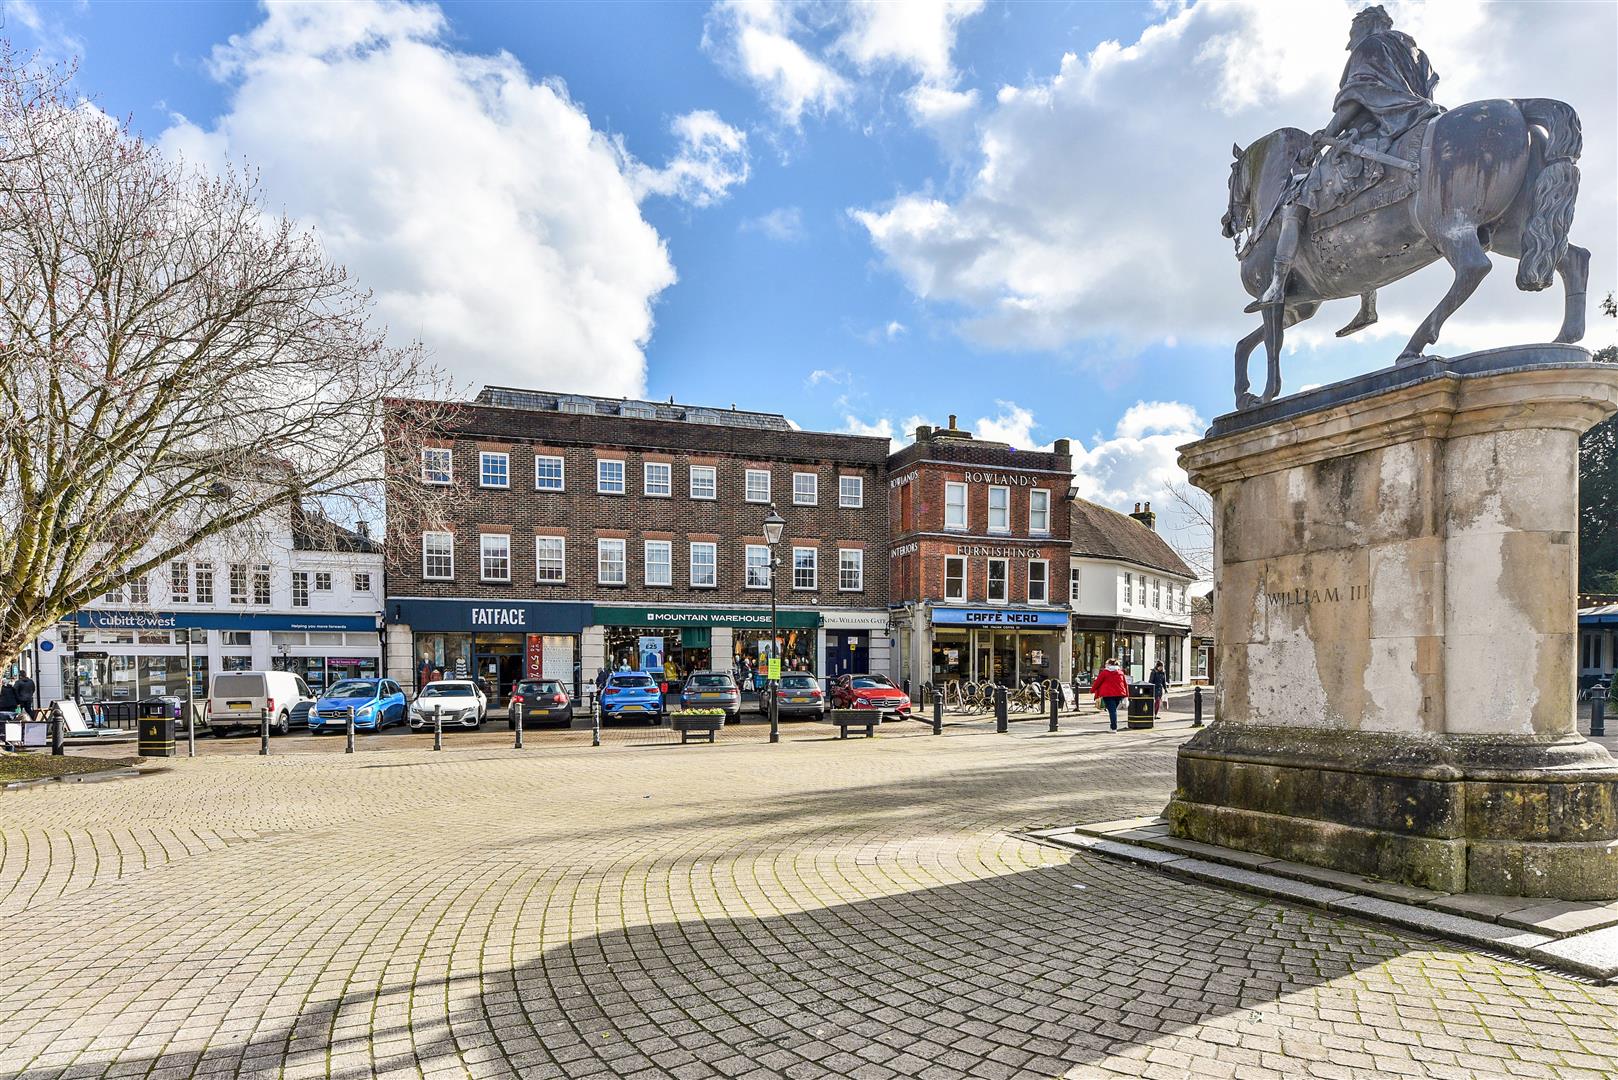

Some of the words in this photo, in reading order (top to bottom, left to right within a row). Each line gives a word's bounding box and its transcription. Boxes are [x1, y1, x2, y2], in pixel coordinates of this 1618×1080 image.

[965, 471, 1038, 487] ROWLAND'S
[957, 545, 1041, 558] FURNISHINGS
[1267, 587, 1340, 606] WILLIAM
[1350, 584, 1368, 601] III
[471, 608, 526, 625] FATFACE
[655, 613, 708, 621] MOUNTAIN
[711, 614, 772, 622] WAREHOUSE
[1007, 614, 1038, 622] NERO
